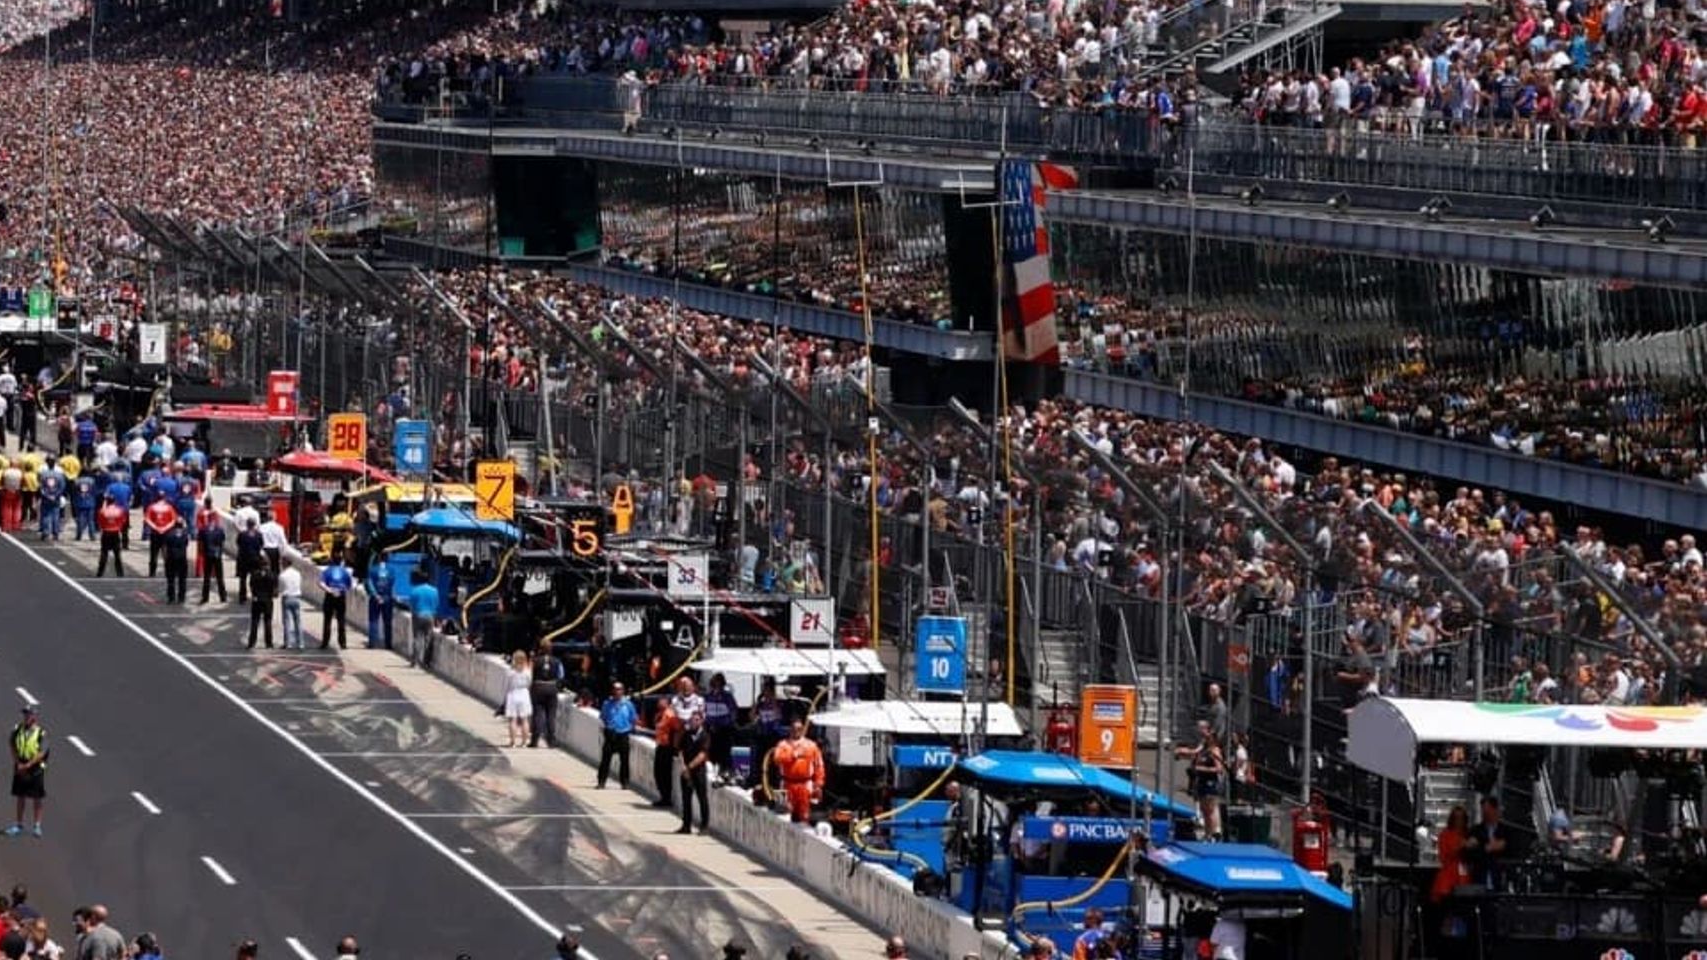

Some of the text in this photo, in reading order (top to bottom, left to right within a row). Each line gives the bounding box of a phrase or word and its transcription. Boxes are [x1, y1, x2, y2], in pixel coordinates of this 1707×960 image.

[333, 422, 361, 451] 28
[484, 475, 506, 507] 7
[573, 520, 599, 556] 5
[678, 567, 696, 584] 33
[801, 613, 820, 631] 21
[931, 658, 950, 679] 10
[1100, 728, 1114, 752] 9
